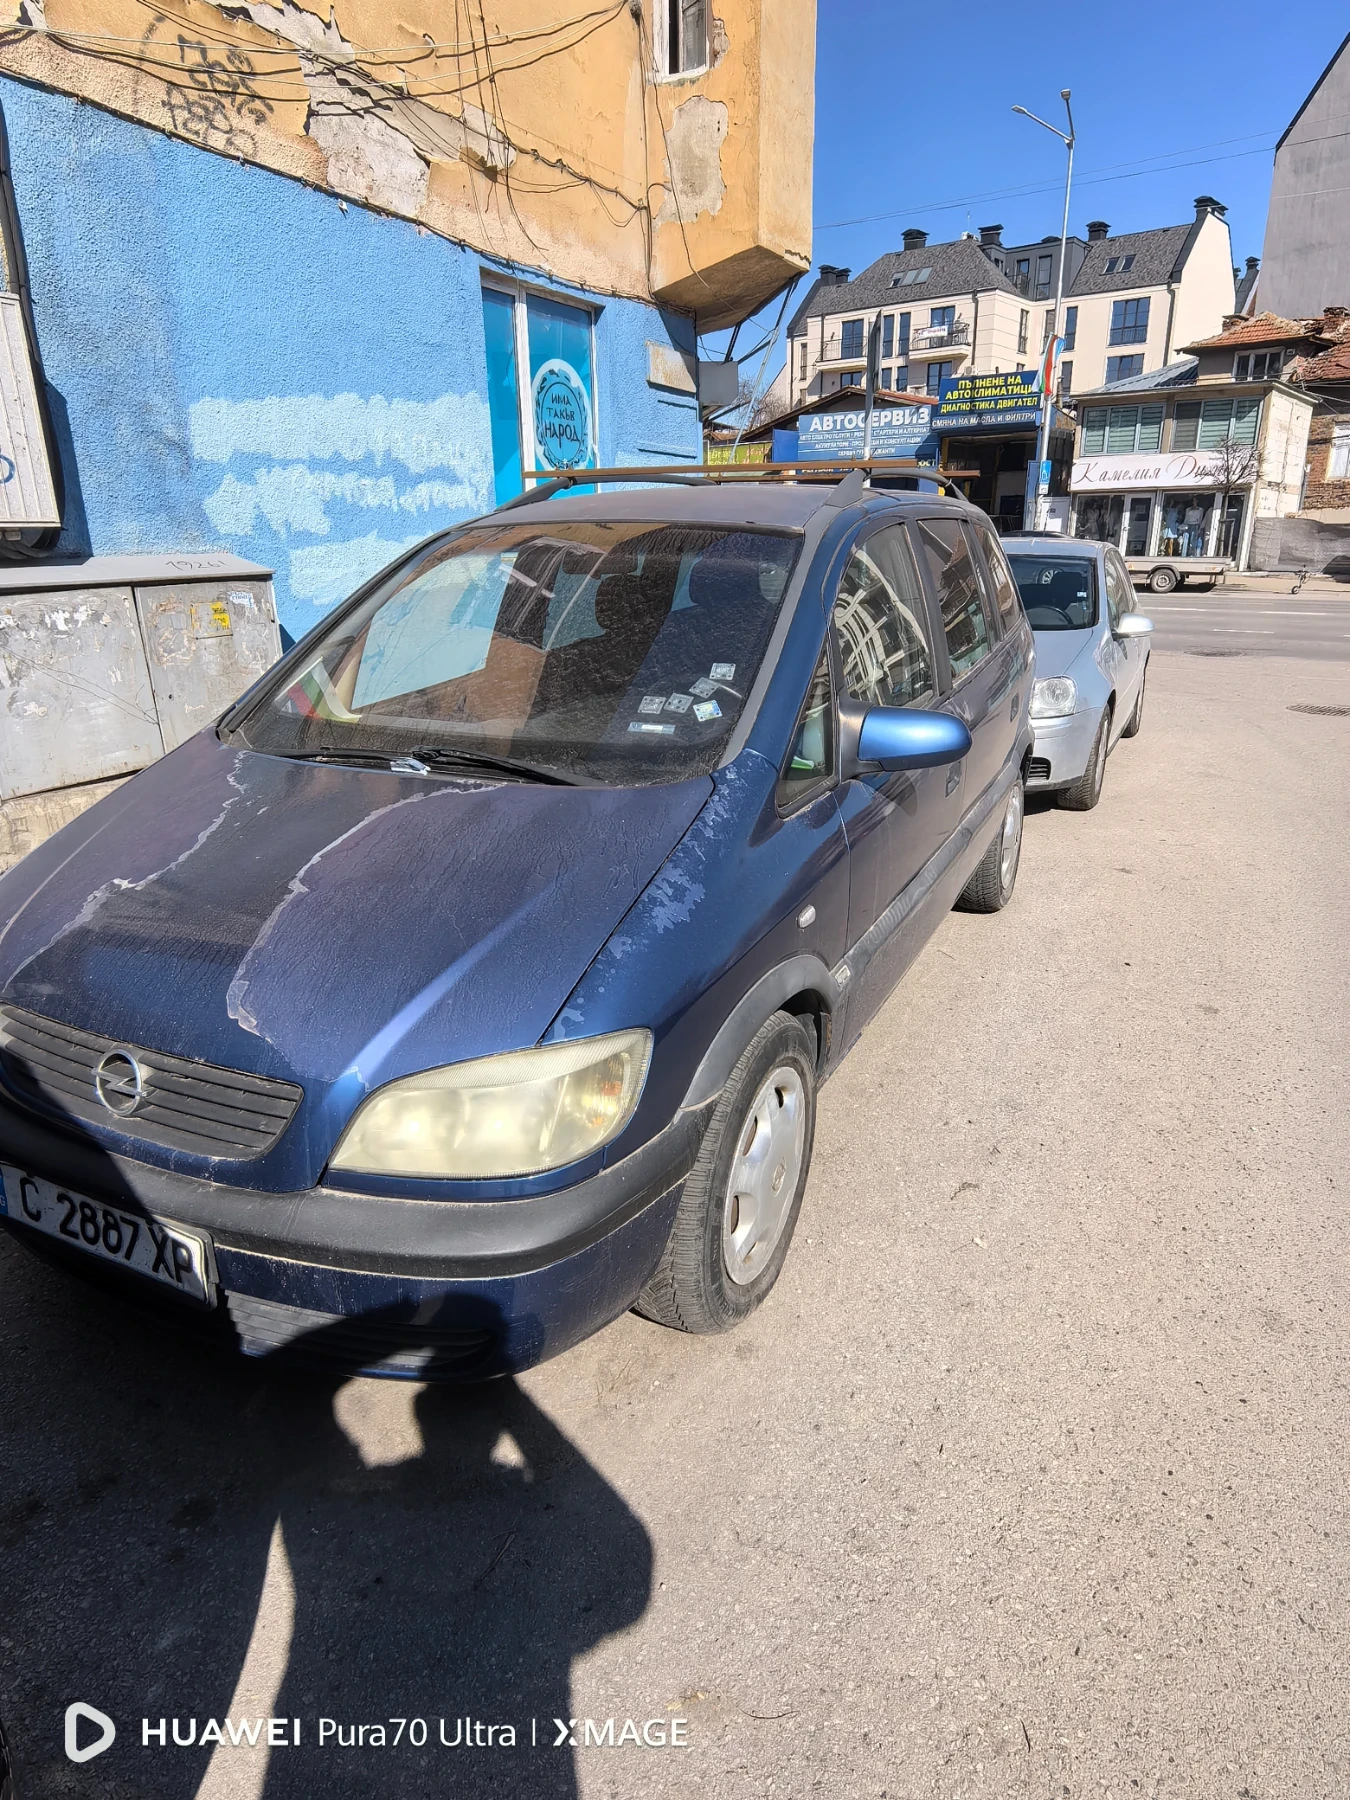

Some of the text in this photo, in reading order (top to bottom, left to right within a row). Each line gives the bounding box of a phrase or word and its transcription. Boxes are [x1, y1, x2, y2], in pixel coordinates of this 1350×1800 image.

[958, 375, 1022, 389] ПЪЛНЕНЕ НА
[551, 393, 572, 406] ИМА
[941, 397, 1037, 413] ДИАГНОСТИКА ДВИГАТЕЛ
[546, 407, 575, 421] ТАКЪВ
[809, 407, 929, 431] АВТОСЕРВИЗ
[958, 417, 969, 425] НА
[1005, 412, 1035, 420] ФИЛТРИ
[544, 421, 581, 449] НАРОД
[1072, 460, 1161, 484] Камелия
[56, 1193, 139, 1261] 2887
